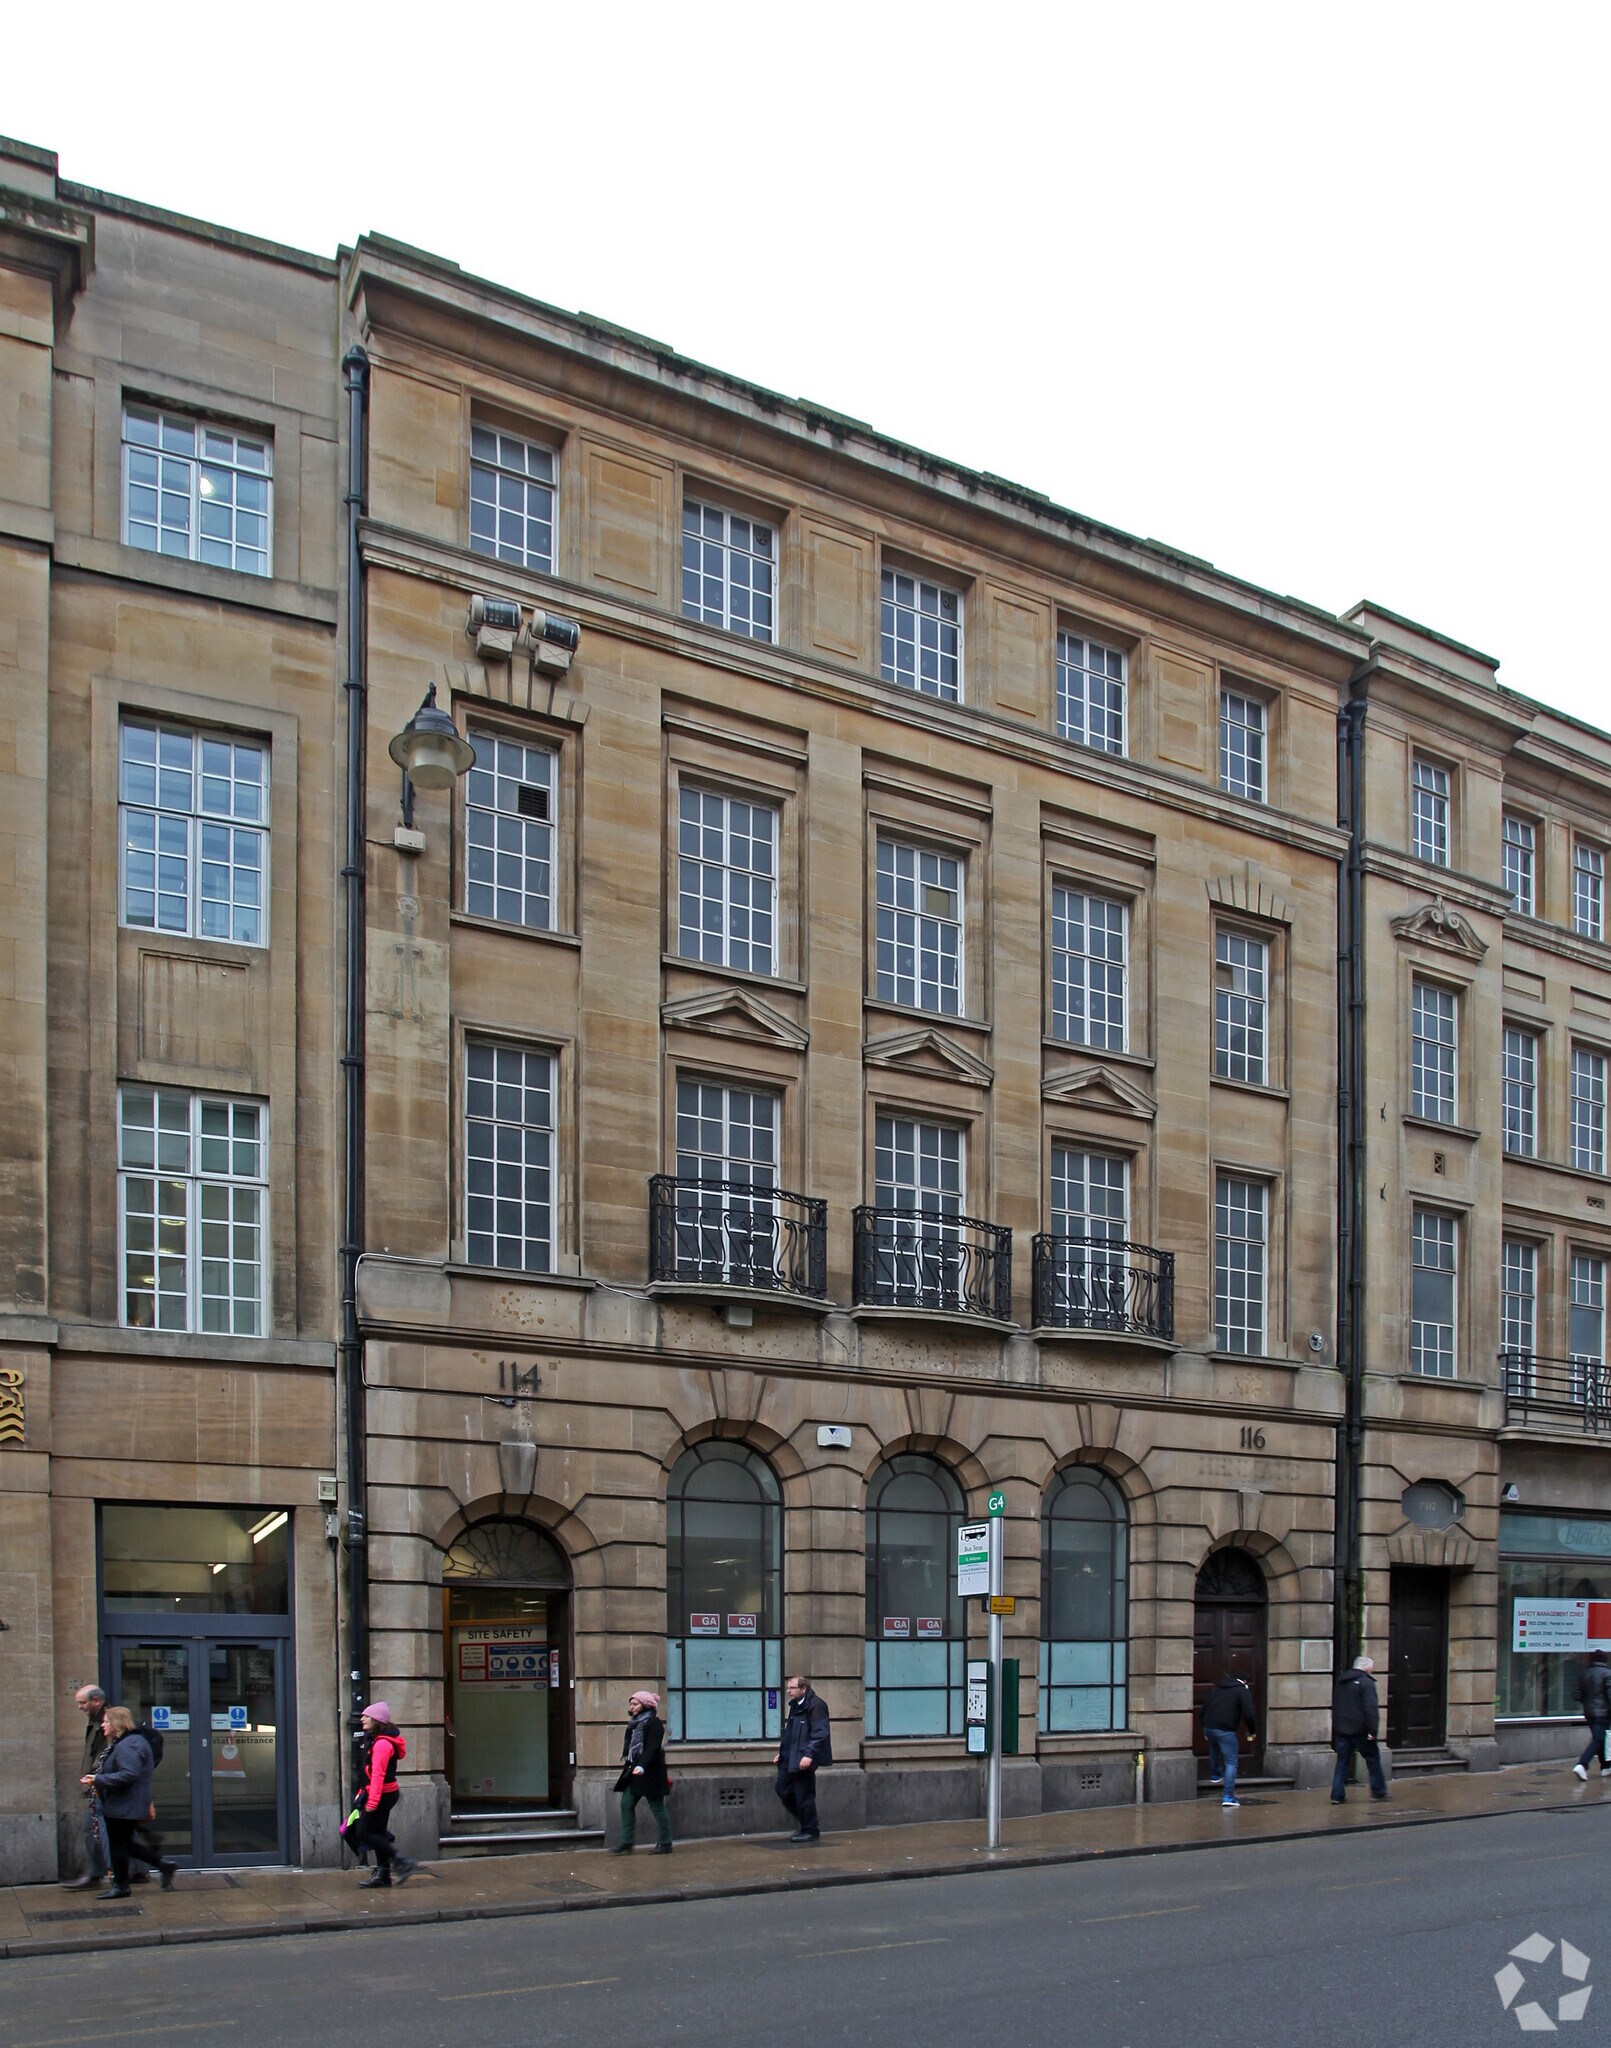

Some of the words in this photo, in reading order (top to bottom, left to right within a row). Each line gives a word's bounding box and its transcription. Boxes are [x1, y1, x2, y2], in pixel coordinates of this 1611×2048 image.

[498, 1360, 542, 1391] 114
[1240, 1425, 1266, 1449] 116
[988, 1495, 1004, 1511] G4
[702, 1617, 717, 1626] GA
[739, 1617, 754, 1626] GA
[894, 1620, 907, 1628] GA
[927, 1620, 940, 1628] GA
[468, 1630, 490, 1640] SITE
[493, 1629, 533, 1639] SAFETY
